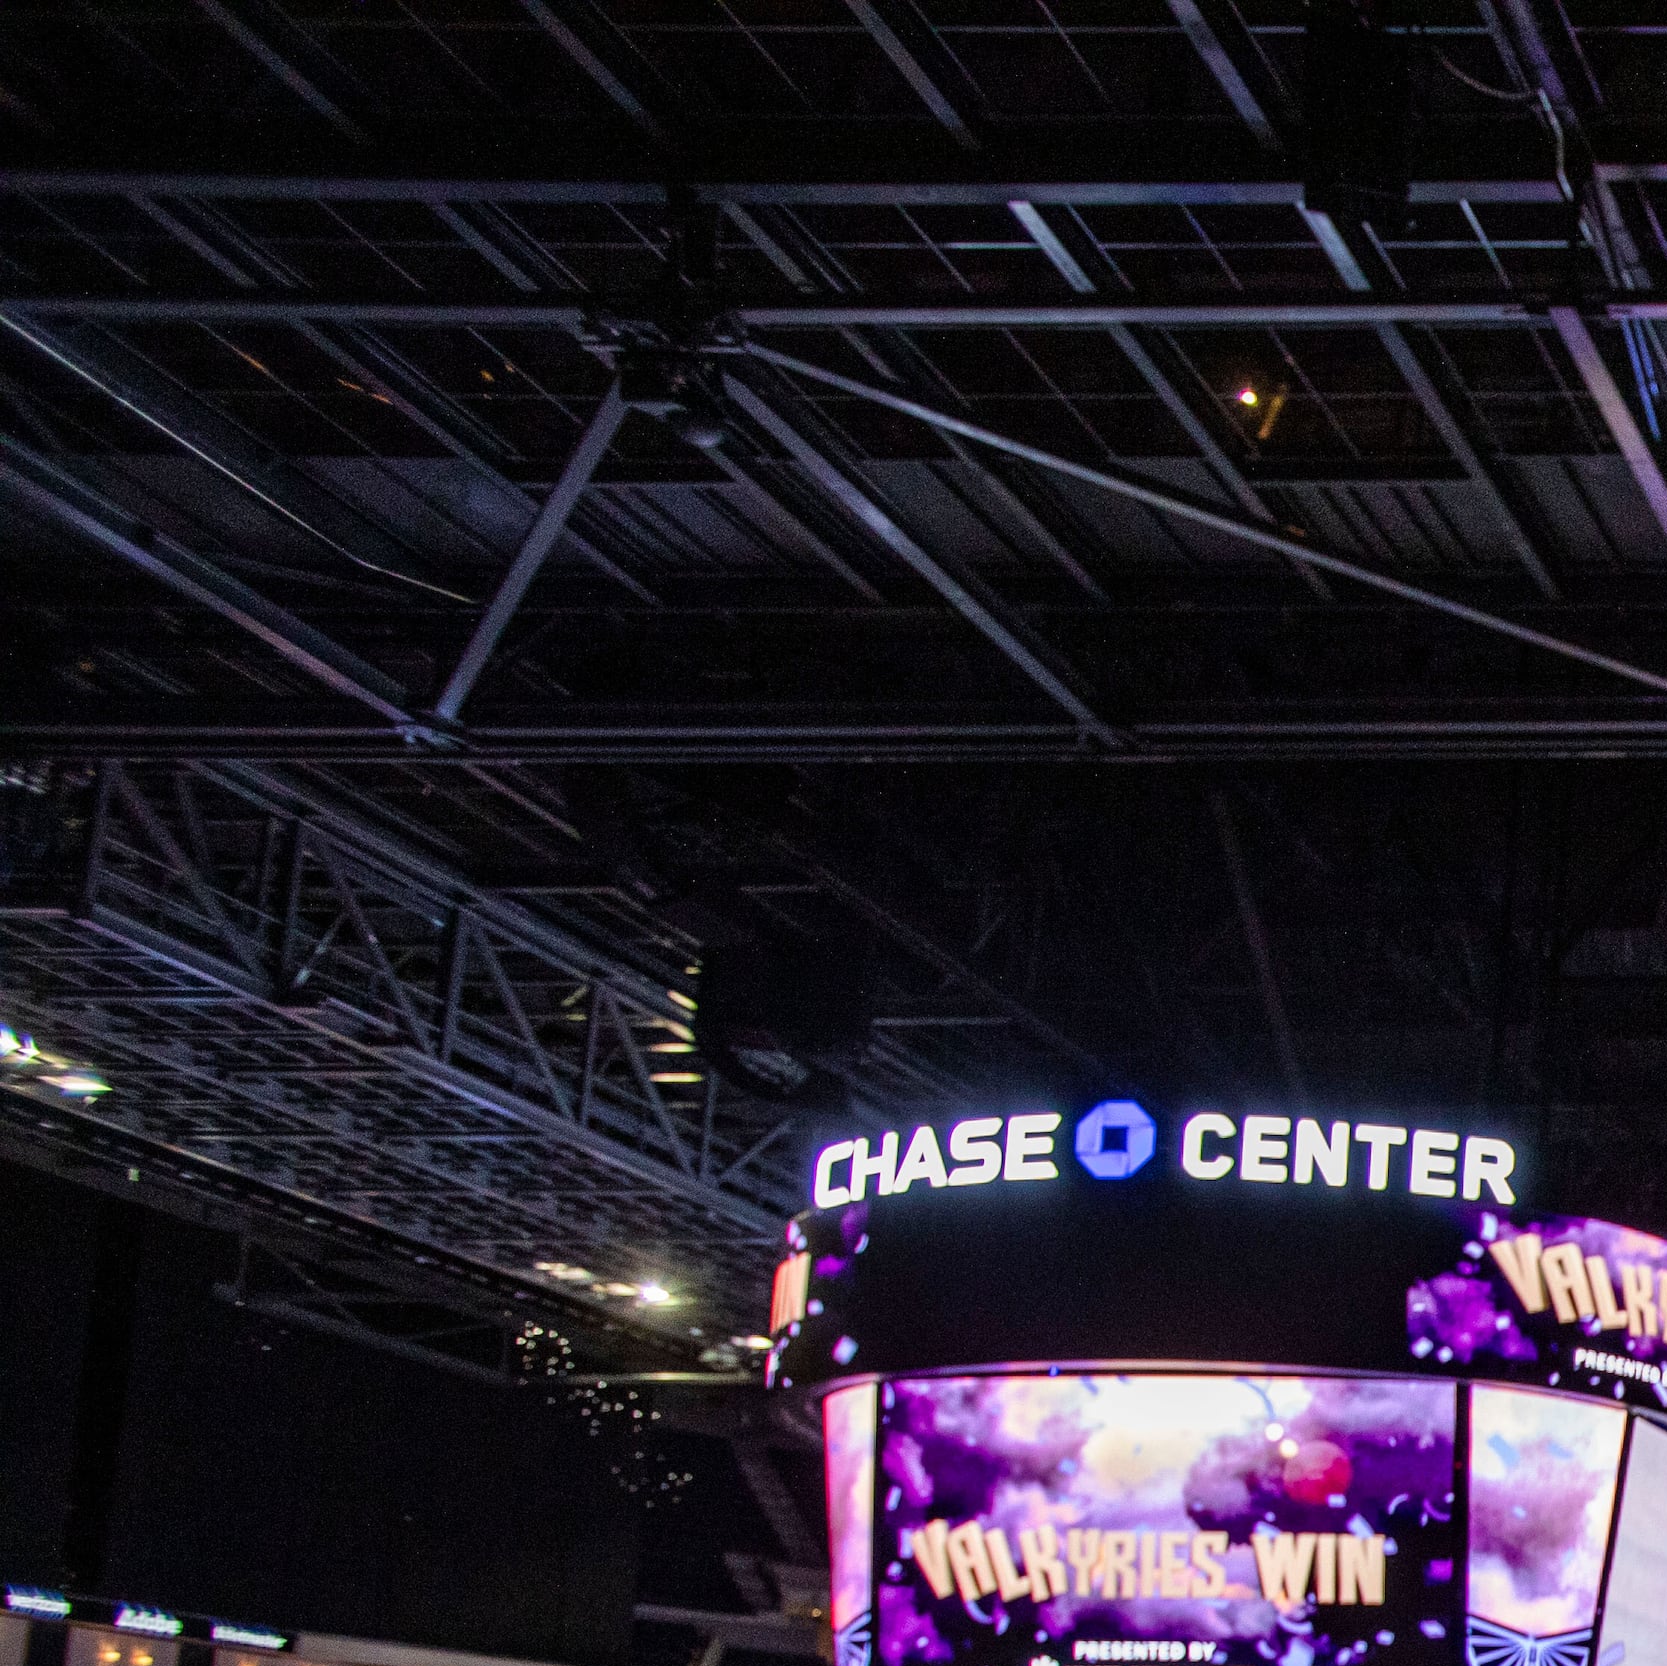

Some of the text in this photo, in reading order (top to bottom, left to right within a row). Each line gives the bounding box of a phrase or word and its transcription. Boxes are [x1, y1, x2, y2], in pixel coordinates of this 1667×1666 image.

[814, 1112, 1518, 1208] CHASE CENTER
[911, 1520, 1386, 1605] VALKYRIES WIN
[1074, 1641, 1216, 1662] PRESENTED BY
